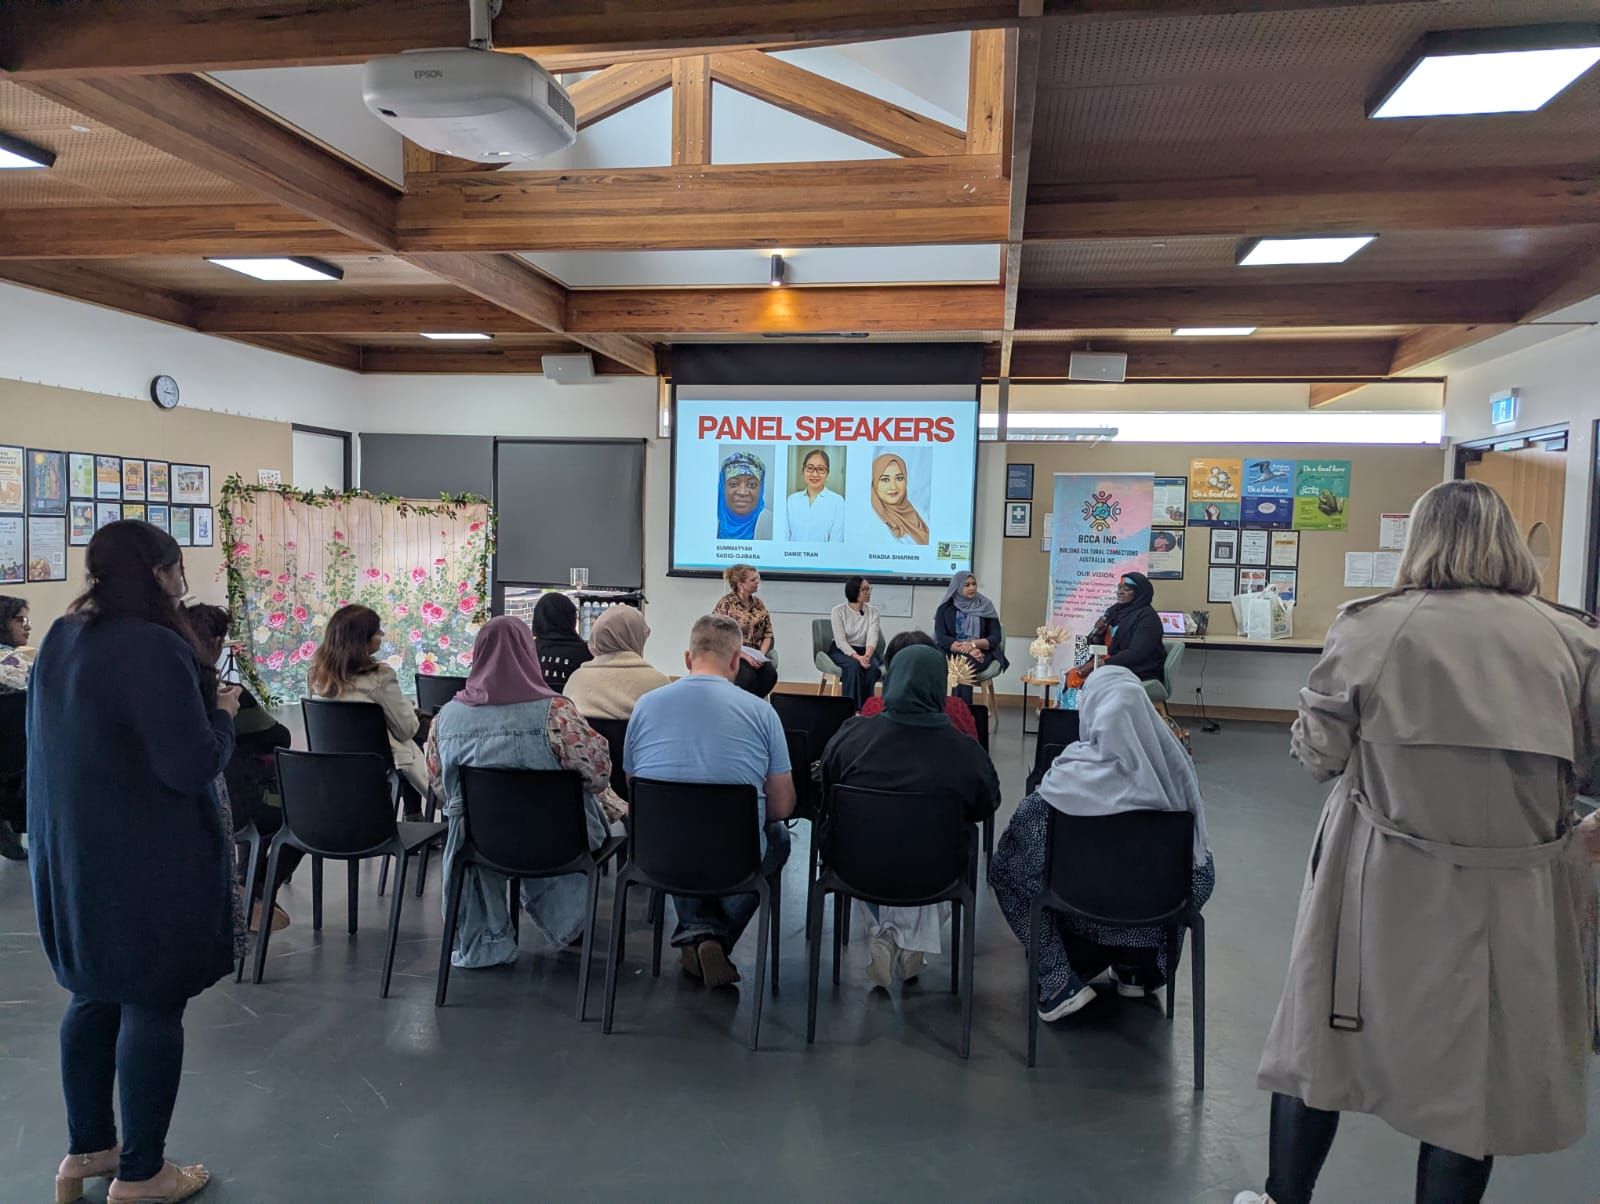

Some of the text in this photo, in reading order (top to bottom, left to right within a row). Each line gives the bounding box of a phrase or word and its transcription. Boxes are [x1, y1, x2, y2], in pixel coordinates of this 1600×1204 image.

[414, 69, 443, 79] EPSON
[698, 415, 955, 443] PANEL SPEAKERS
[1078, 534, 1119, 545] BCCA INC.
[1081, 548, 1105, 556] CULTURAL
[1106, 549, 1139, 557] CONNECTIONS
[1079, 556, 1106, 564] AUSTRALIA
